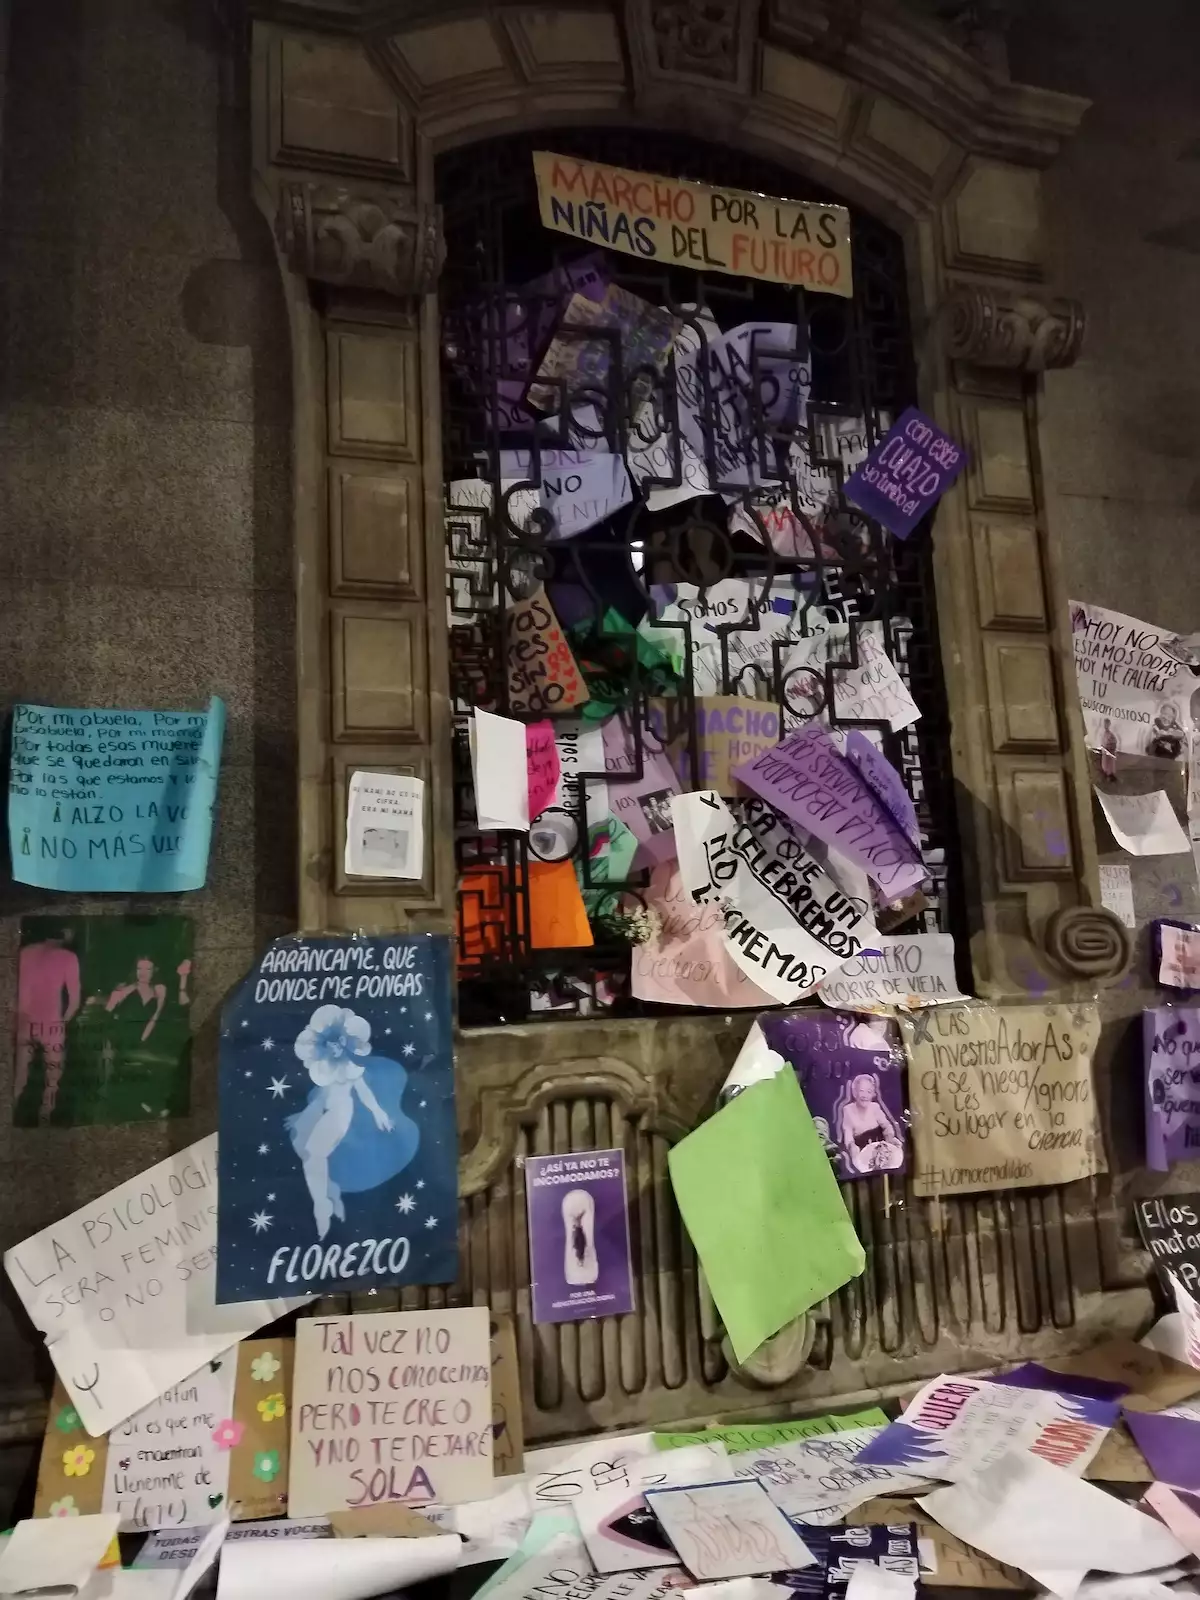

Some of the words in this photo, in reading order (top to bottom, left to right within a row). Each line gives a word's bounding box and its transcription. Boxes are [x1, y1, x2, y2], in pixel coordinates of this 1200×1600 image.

[552, 159, 695, 223] MARCHO
[710, 193, 759, 230] POR
[775, 206, 837, 249] LAS
[550, 195, 656, 256] NIÑAS
[671, 225, 726, 267] DEL
[732, 234, 839, 286] FUTURO
[878, 435, 941, 497] CULAZO
[542, 474, 583, 498] NO
[1085, 618, 1125, 644] HOY
[1125, 628, 1160, 651] NO
[1074, 638, 1135, 666] ESTAMOS
[1136, 651, 1182, 677] TODAS
[1075, 656, 1097, 674] HOY
[1102, 662, 1124, 684] ME
[1122, 667, 1169, 692] FALTAS
[15, 706, 44, 725] Por
[154, 712, 180, 726] Por
[46, 740, 93, 754] todas
[99, 740, 137, 752] esas
[142, 740, 201, 752] mujere
[48, 755, 66, 768] se
[73, 753, 144, 769] quedaron
[151, 755, 169, 767] en
[43, 772, 68, 785] las
[76, 774, 101, 791] que
[107, 773, 164, 785] estamos
[752, 753, 848, 822] ABOGADA
[136, 801, 159, 819] LA
[88, 830, 146, 860] MÁS
[836, 816, 873, 845] LA
[859, 841, 918, 886] SOY
[732, 823, 862, 960] CELEBREMOS
[776, 837, 826, 885] QUE
[824, 890, 863, 930] UN
[382, 946, 419, 970] QUE
[255, 976, 318, 1003] DONDE
[319, 975, 354, 1000] ME
[355, 973, 424, 999] PONGAS
[820, 978, 878, 1002] MORIR
[884, 975, 906, 995] DE
[909, 974, 949, 994] VIEJA
[934, 1011, 971, 1037] LAS
[1152, 1033, 1178, 1055] No
[947, 1070, 972, 1095] se
[1014, 1111, 1036, 1129] en
[1050, 1111, 1066, 1128] la
[533, 1168, 620, 1187] INCOMODAMOS?
[564, 1160, 579, 1171] YA
[579, 1158, 597, 1170] NO
[598, 1157, 611, 1168] TE
[15, 1238, 77, 1287] LA
[82, 1154, 219, 1249] PSICOLOGI
[1141, 1198, 1198, 1228] Ellos
[45, 1271, 115, 1318] SERA
[121, 1204, 218, 1273] FEMINIS
[266, 1236, 411, 1284] FLOREZCO
[125, 1278, 163, 1309] NO
[314, 1321, 353, 1356] Tal
[364, 1328, 408, 1354] vez
[416, 1327, 451, 1354] no
[327, 1365, 380, 1394] nos
[299, 1401, 361, 1433] PERO
[366, 1400, 398, 1425] TE
[403, 1397, 472, 1427] CREO
[912, 1382, 981, 1431] QUIERO
[165, 1414, 189, 1438] que
[308, 1438, 324, 1468] Y
[328, 1437, 360, 1465] NO
[370, 1436, 406, 1464] TE
[195, 1465, 212, 1486] de
[346, 1464, 437, 1505] SOLA
[225, 1526, 279, 1541] ESTRAS
